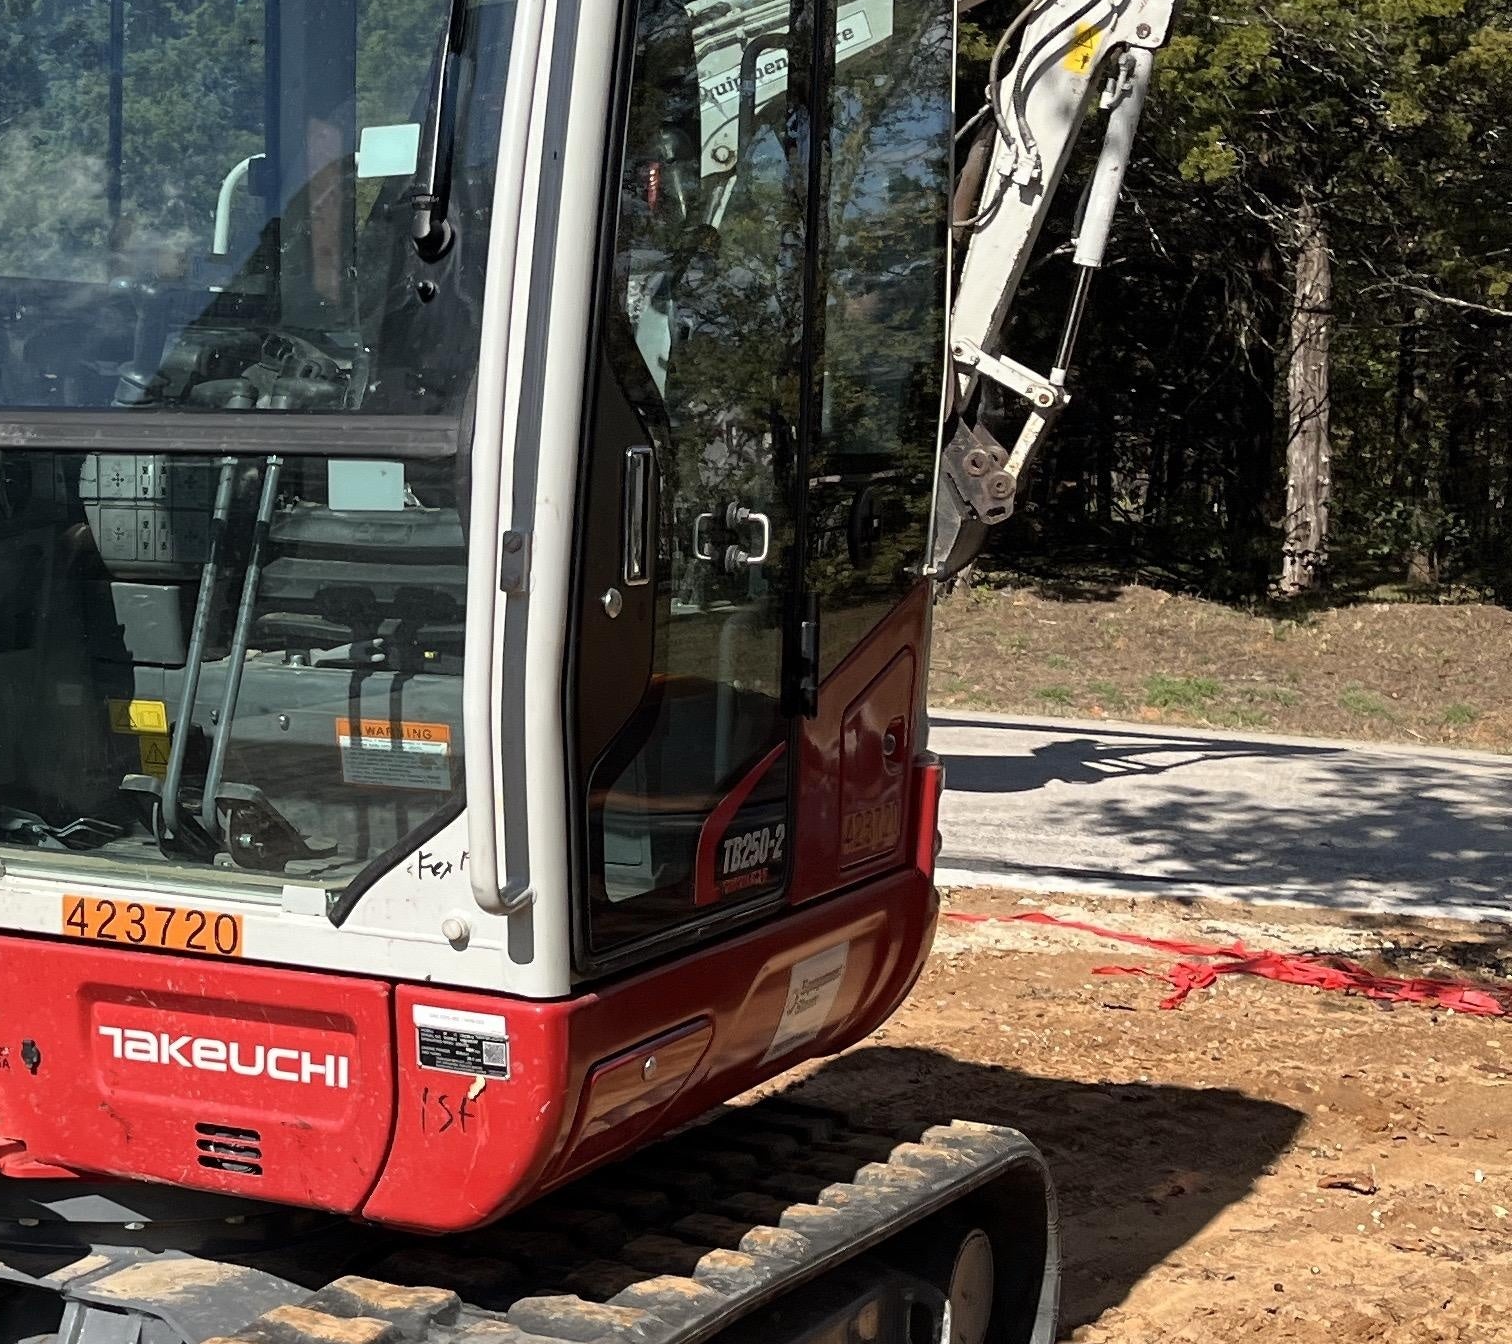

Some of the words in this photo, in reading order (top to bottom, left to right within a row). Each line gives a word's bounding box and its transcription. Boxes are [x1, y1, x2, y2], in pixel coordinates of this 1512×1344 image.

[365, 725, 433, 740] WARING
[723, 823, 786, 875] TB250-2
[66, 897, 239, 955] 423720
